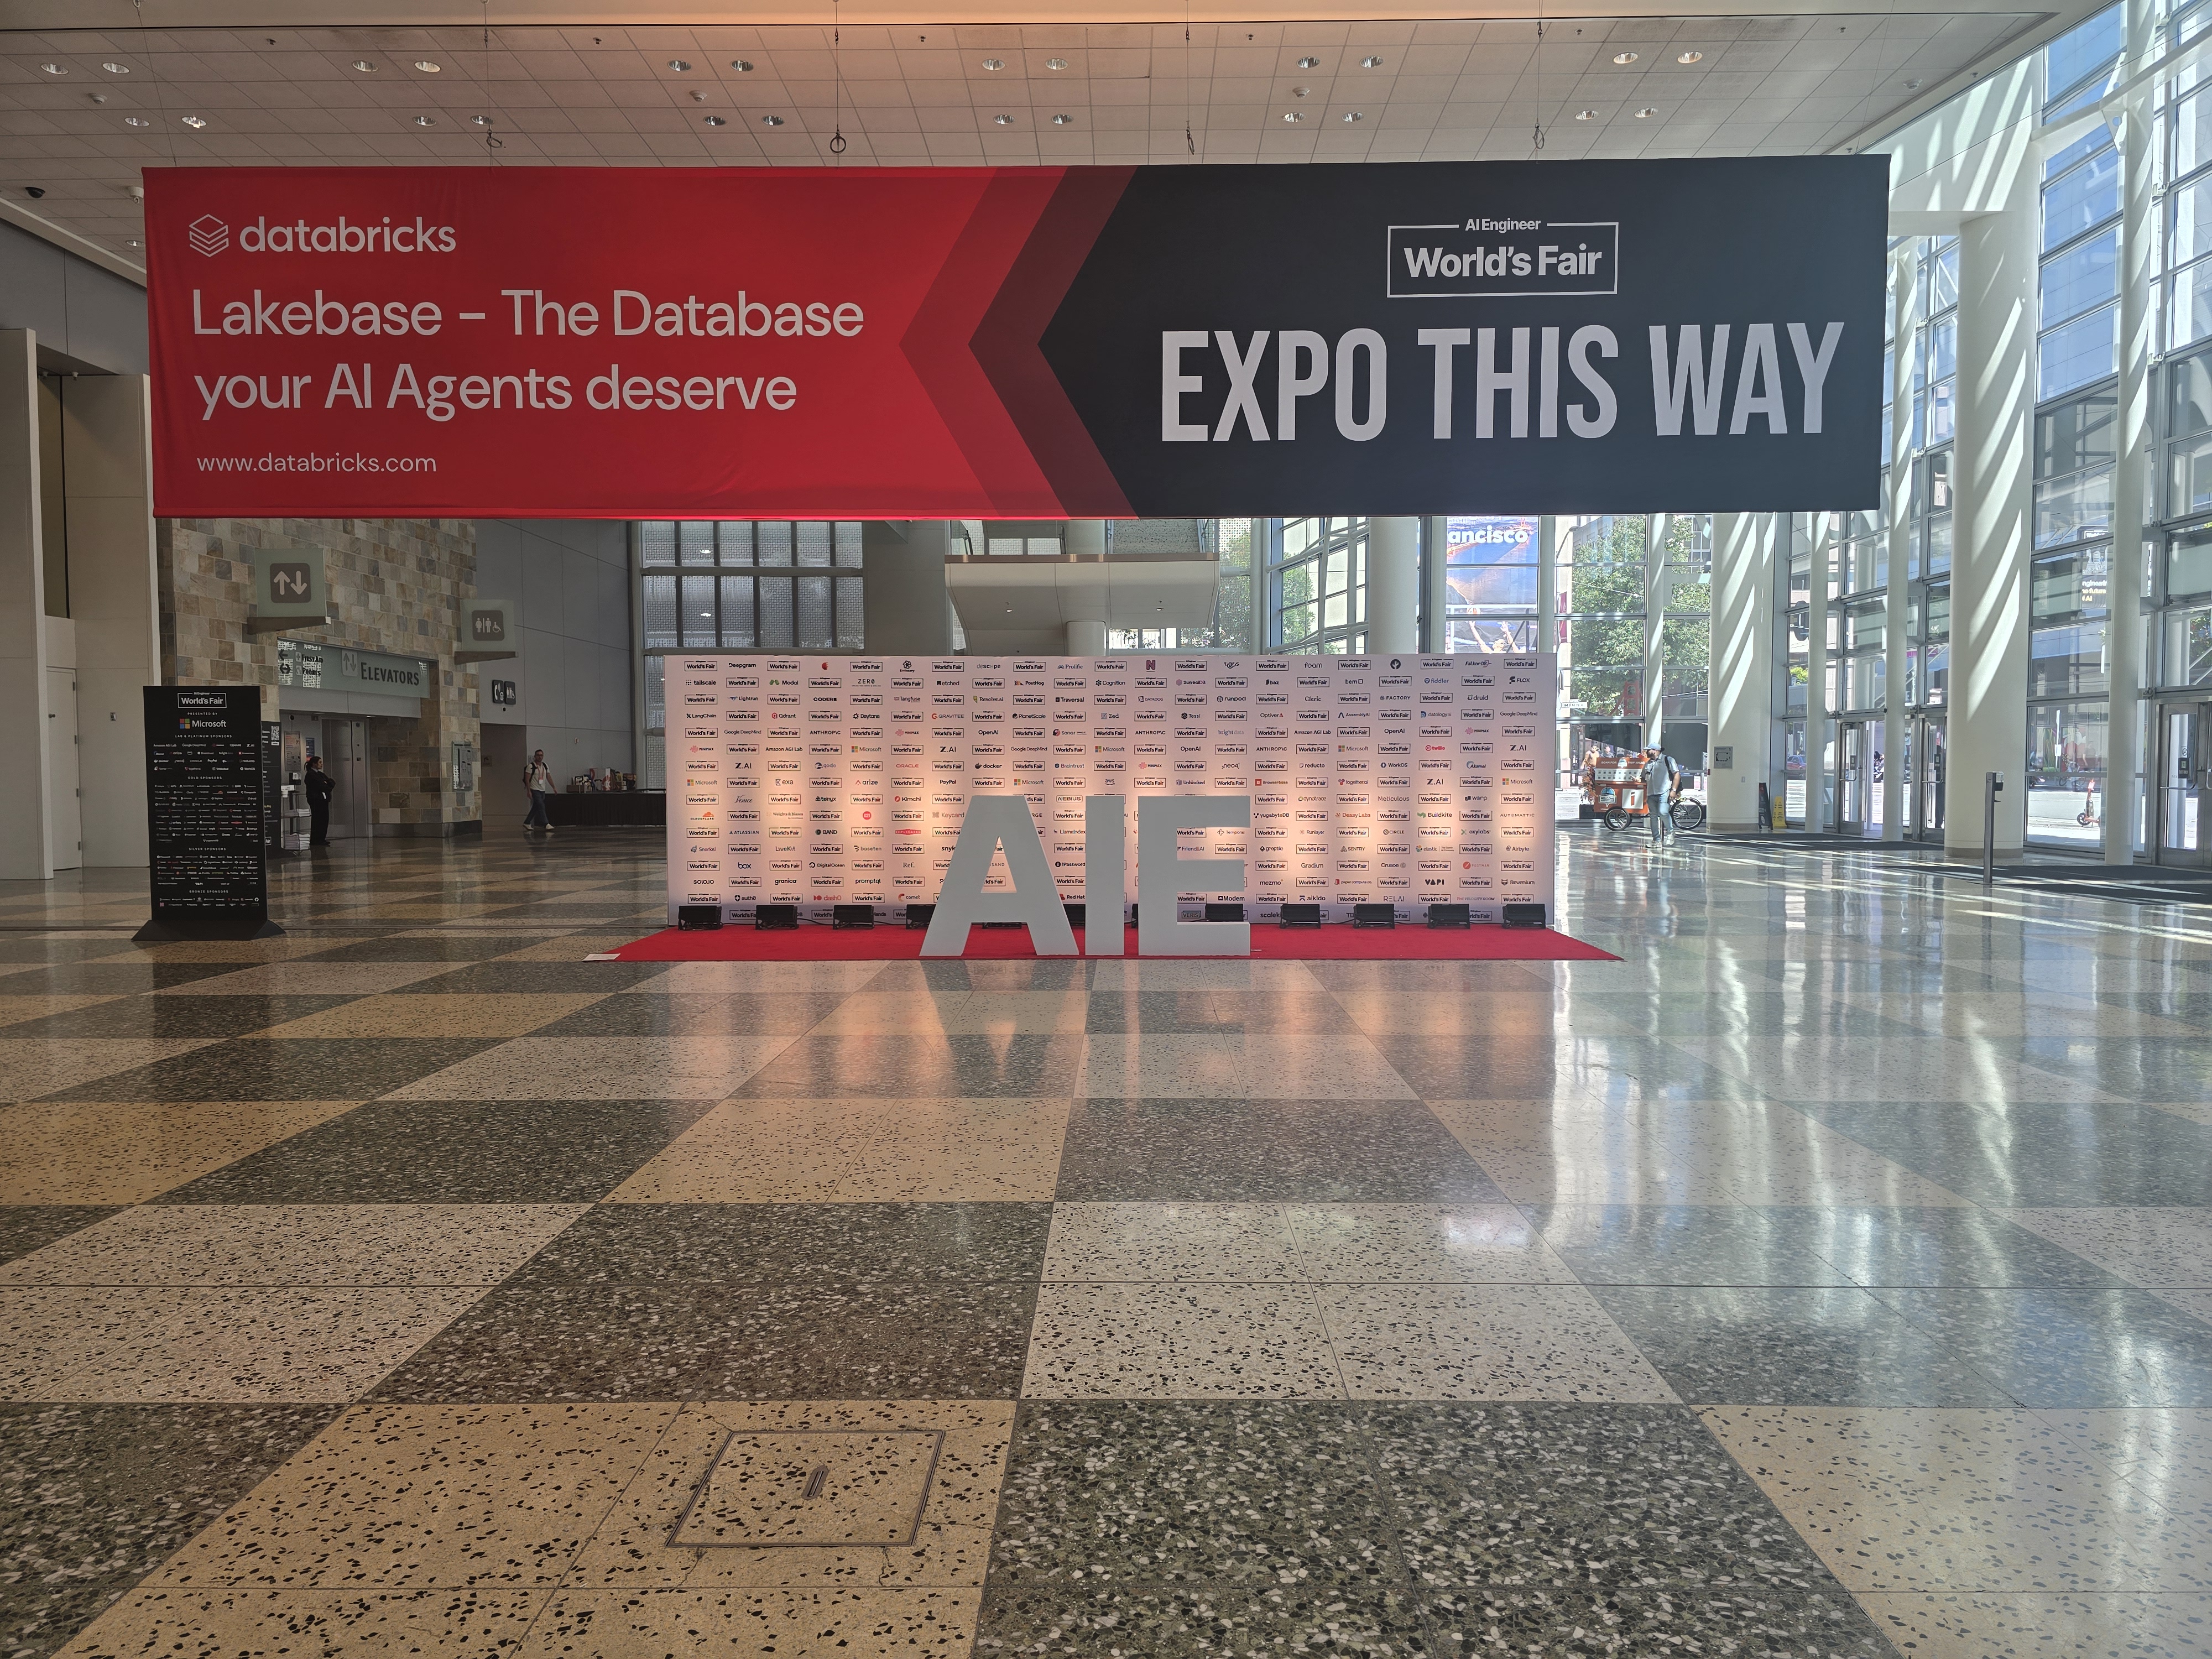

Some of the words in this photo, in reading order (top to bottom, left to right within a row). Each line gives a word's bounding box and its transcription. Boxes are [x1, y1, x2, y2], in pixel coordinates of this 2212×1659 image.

[240, 216, 456, 252] databricks
[1465, 219, 1479, 231] AI
[1482, 218, 1541, 233] Engineer
[1404, 247, 1531, 277] World's
[1538, 243, 1602, 275] Fair
[194, 289, 442, 335] Lakebase
[502, 290, 598, 336] The
[614, 290, 863, 336] Database
[194, 375, 311, 420] your
[325, 363, 372, 408] AI
[387, 364, 572, 421] Agents
[586, 364, 796, 410] deserve
[1162, 328, 1386, 441] EXPO
[1418, 325, 1618, 439] THIS
[1649, 322, 1844, 436] WAY
[197, 452, 436, 472] www.databricks.com
[920, 795, 1250, 956] AIE
